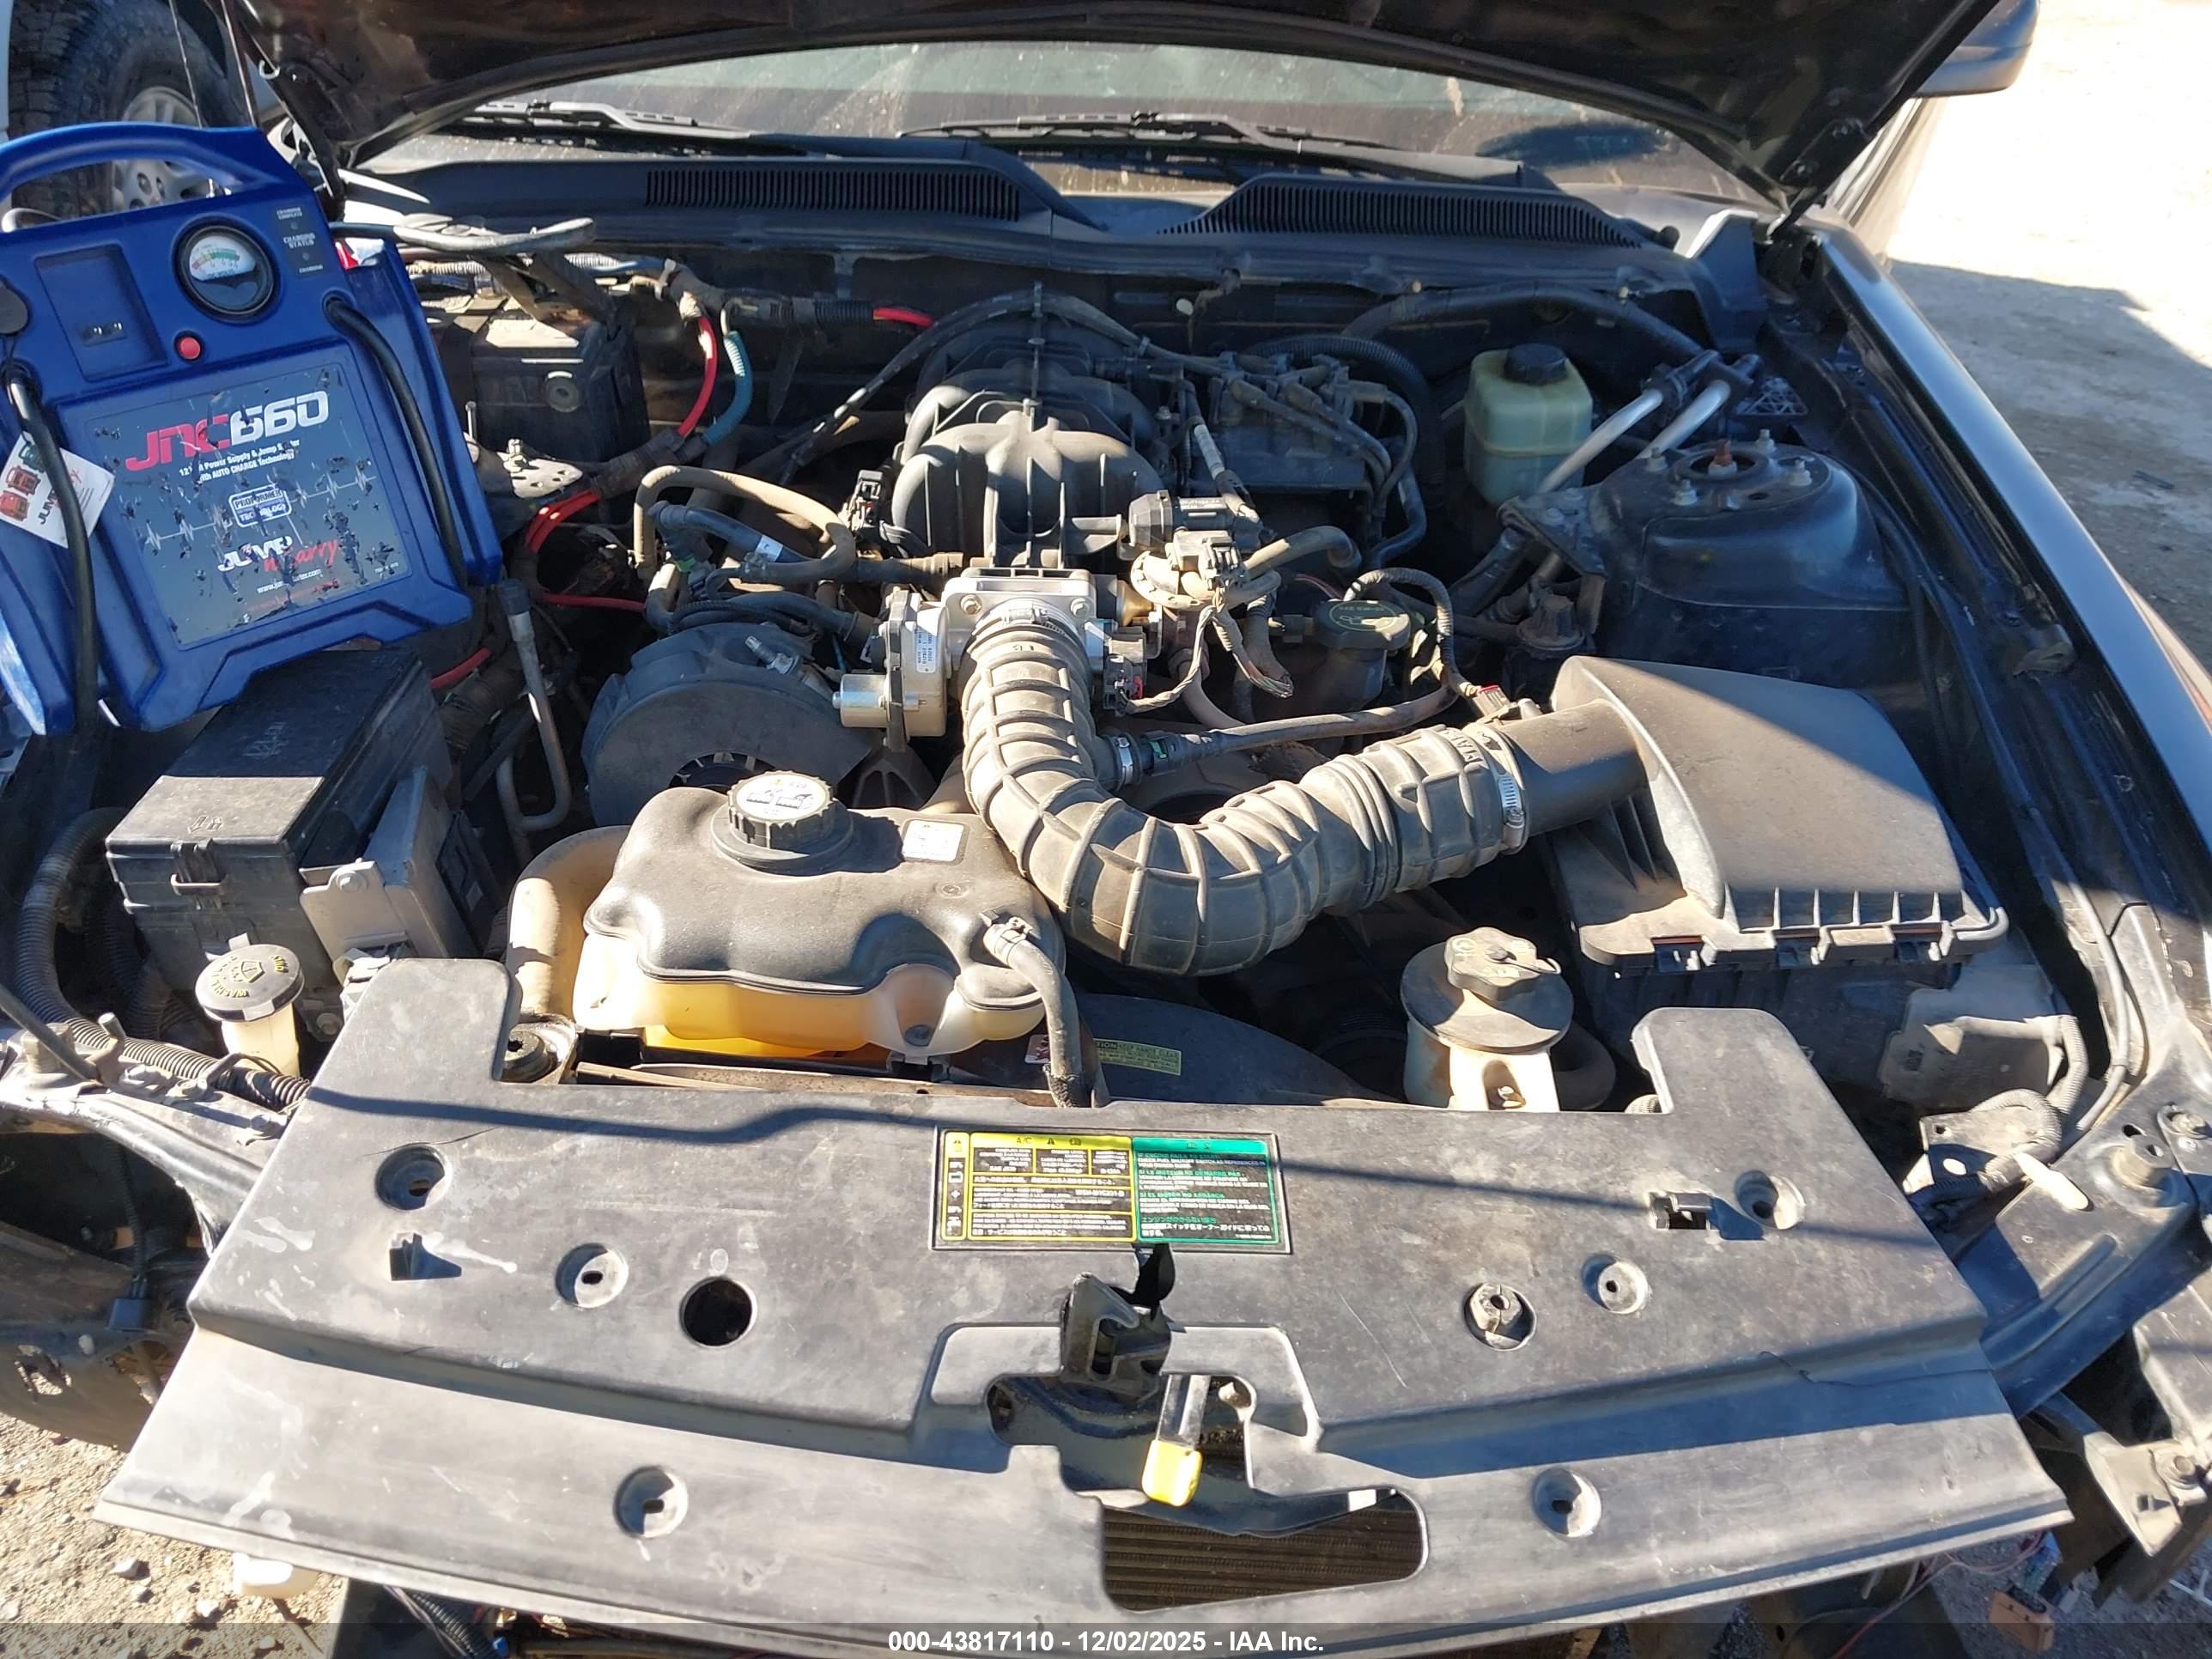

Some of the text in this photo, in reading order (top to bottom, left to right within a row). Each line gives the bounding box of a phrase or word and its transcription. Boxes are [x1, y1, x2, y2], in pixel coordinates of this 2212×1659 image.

[204, 458, 226, 471] Power
[227, 452, 251, 465] Supply
[258, 445, 277, 459] Jump
[212, 465, 230, 479] AUTO
[230, 459, 258, 474] CHARGE
